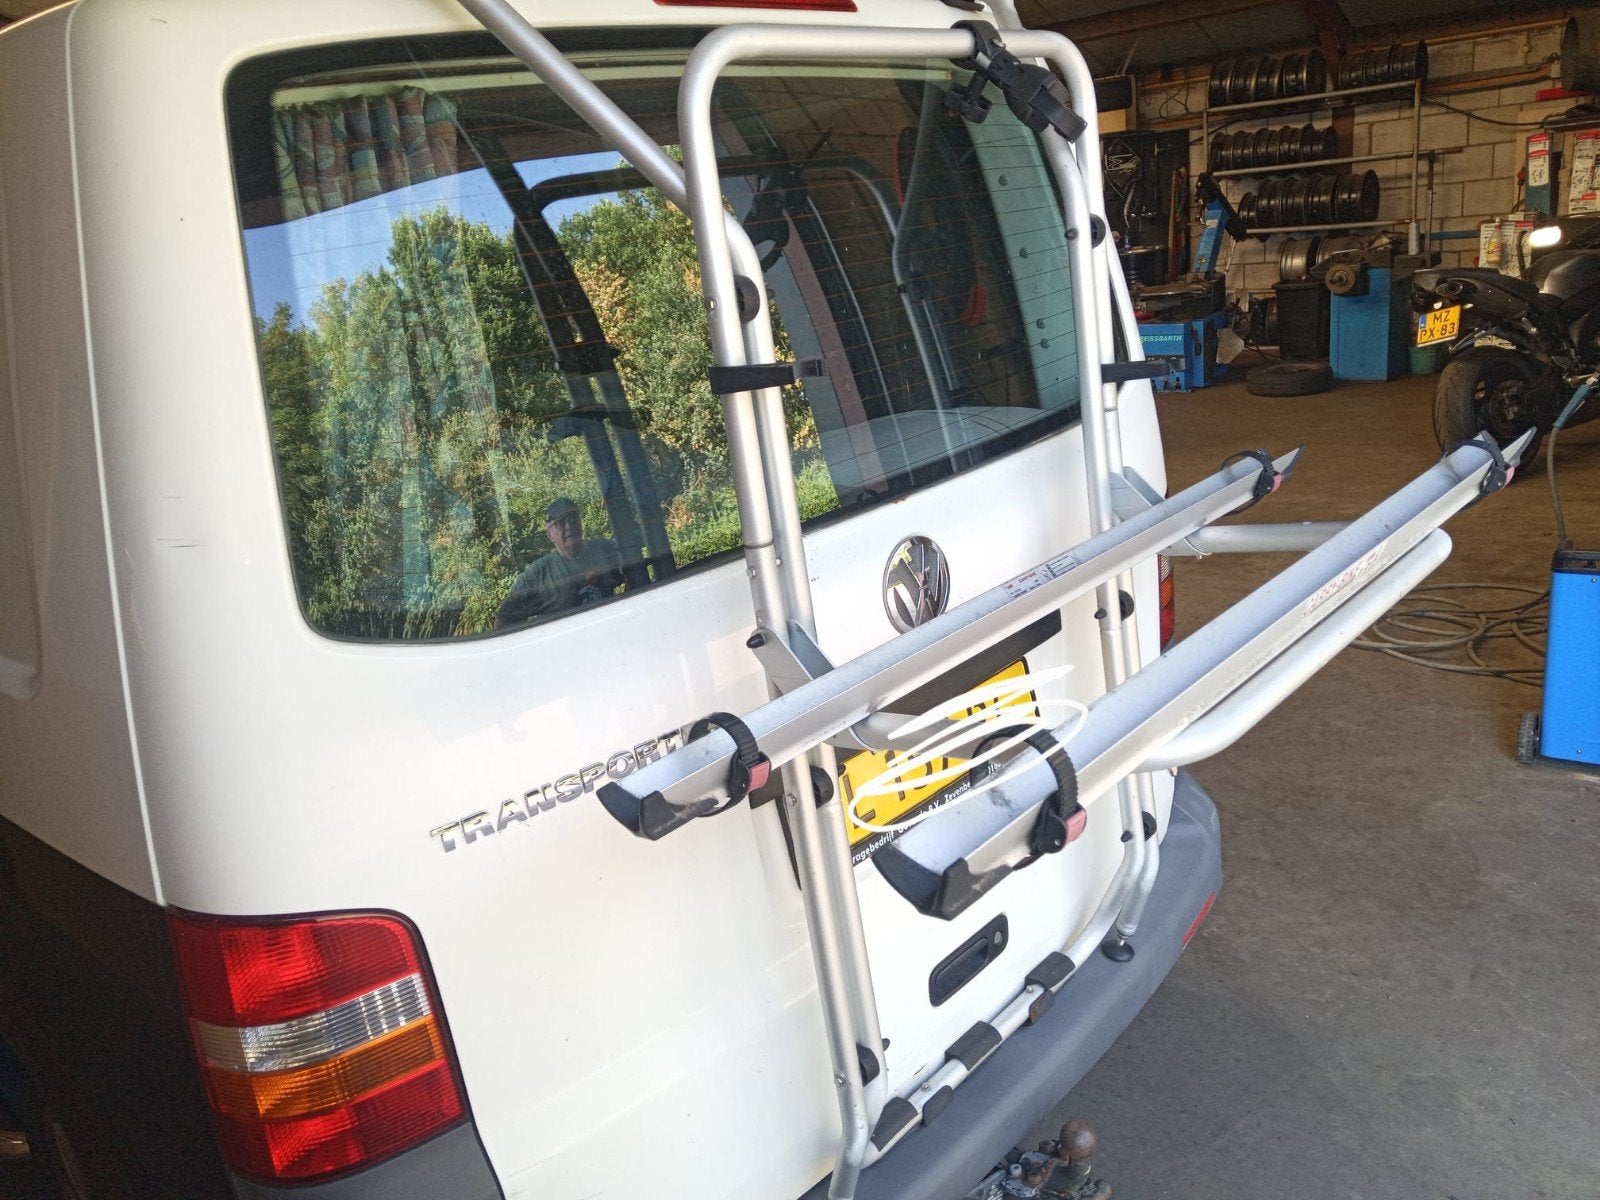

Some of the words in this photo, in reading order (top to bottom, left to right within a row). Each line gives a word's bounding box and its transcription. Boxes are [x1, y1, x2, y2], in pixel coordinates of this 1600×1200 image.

[1433, 310, 1451, 325] MZ
[1420, 322, 1456, 341] PX-83
[852, 829, 895, 864] ragebedrijf
[944, 780, 972, 803] Zevenbe
